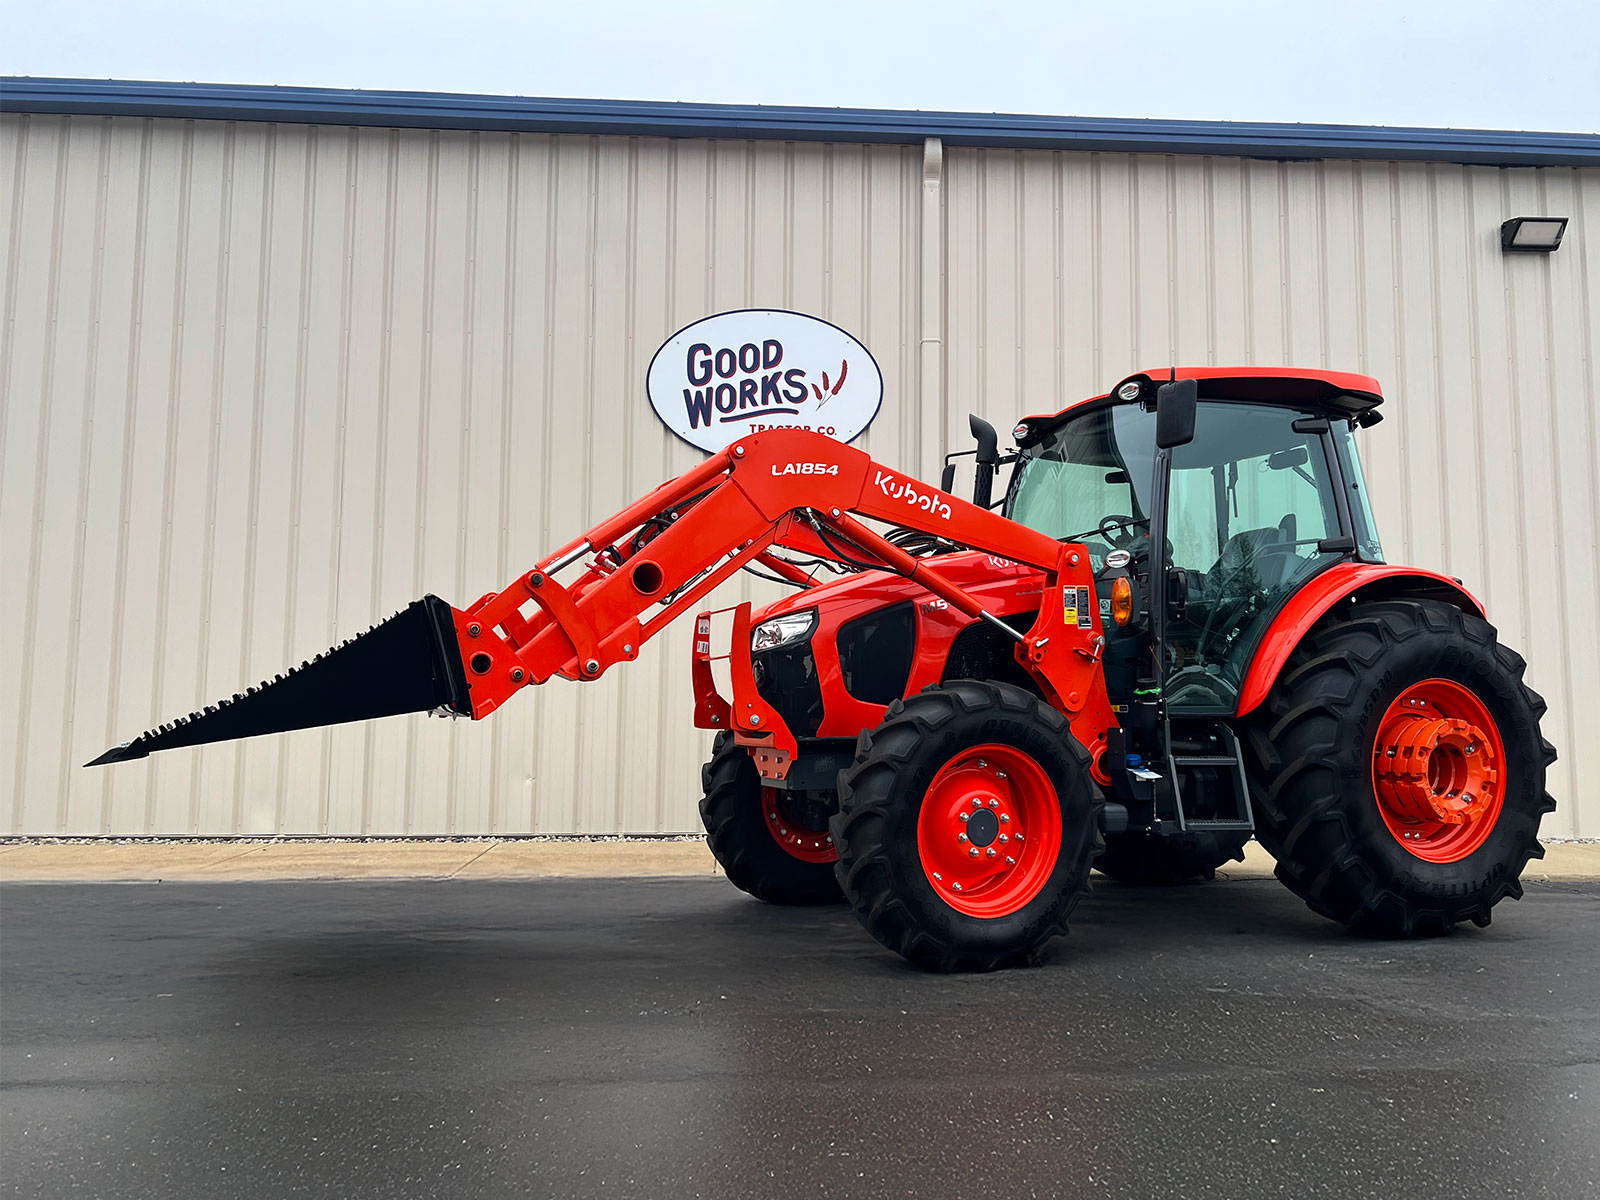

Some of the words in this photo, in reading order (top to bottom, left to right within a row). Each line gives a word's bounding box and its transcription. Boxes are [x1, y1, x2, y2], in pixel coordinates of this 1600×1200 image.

[687, 339, 783, 387] GOOD
[683, 368, 808, 430] WORKS
[817, 426, 837, 436] CO.
[771, 463, 839, 476] LA1854
[874, 470, 952, 520] Kubota
